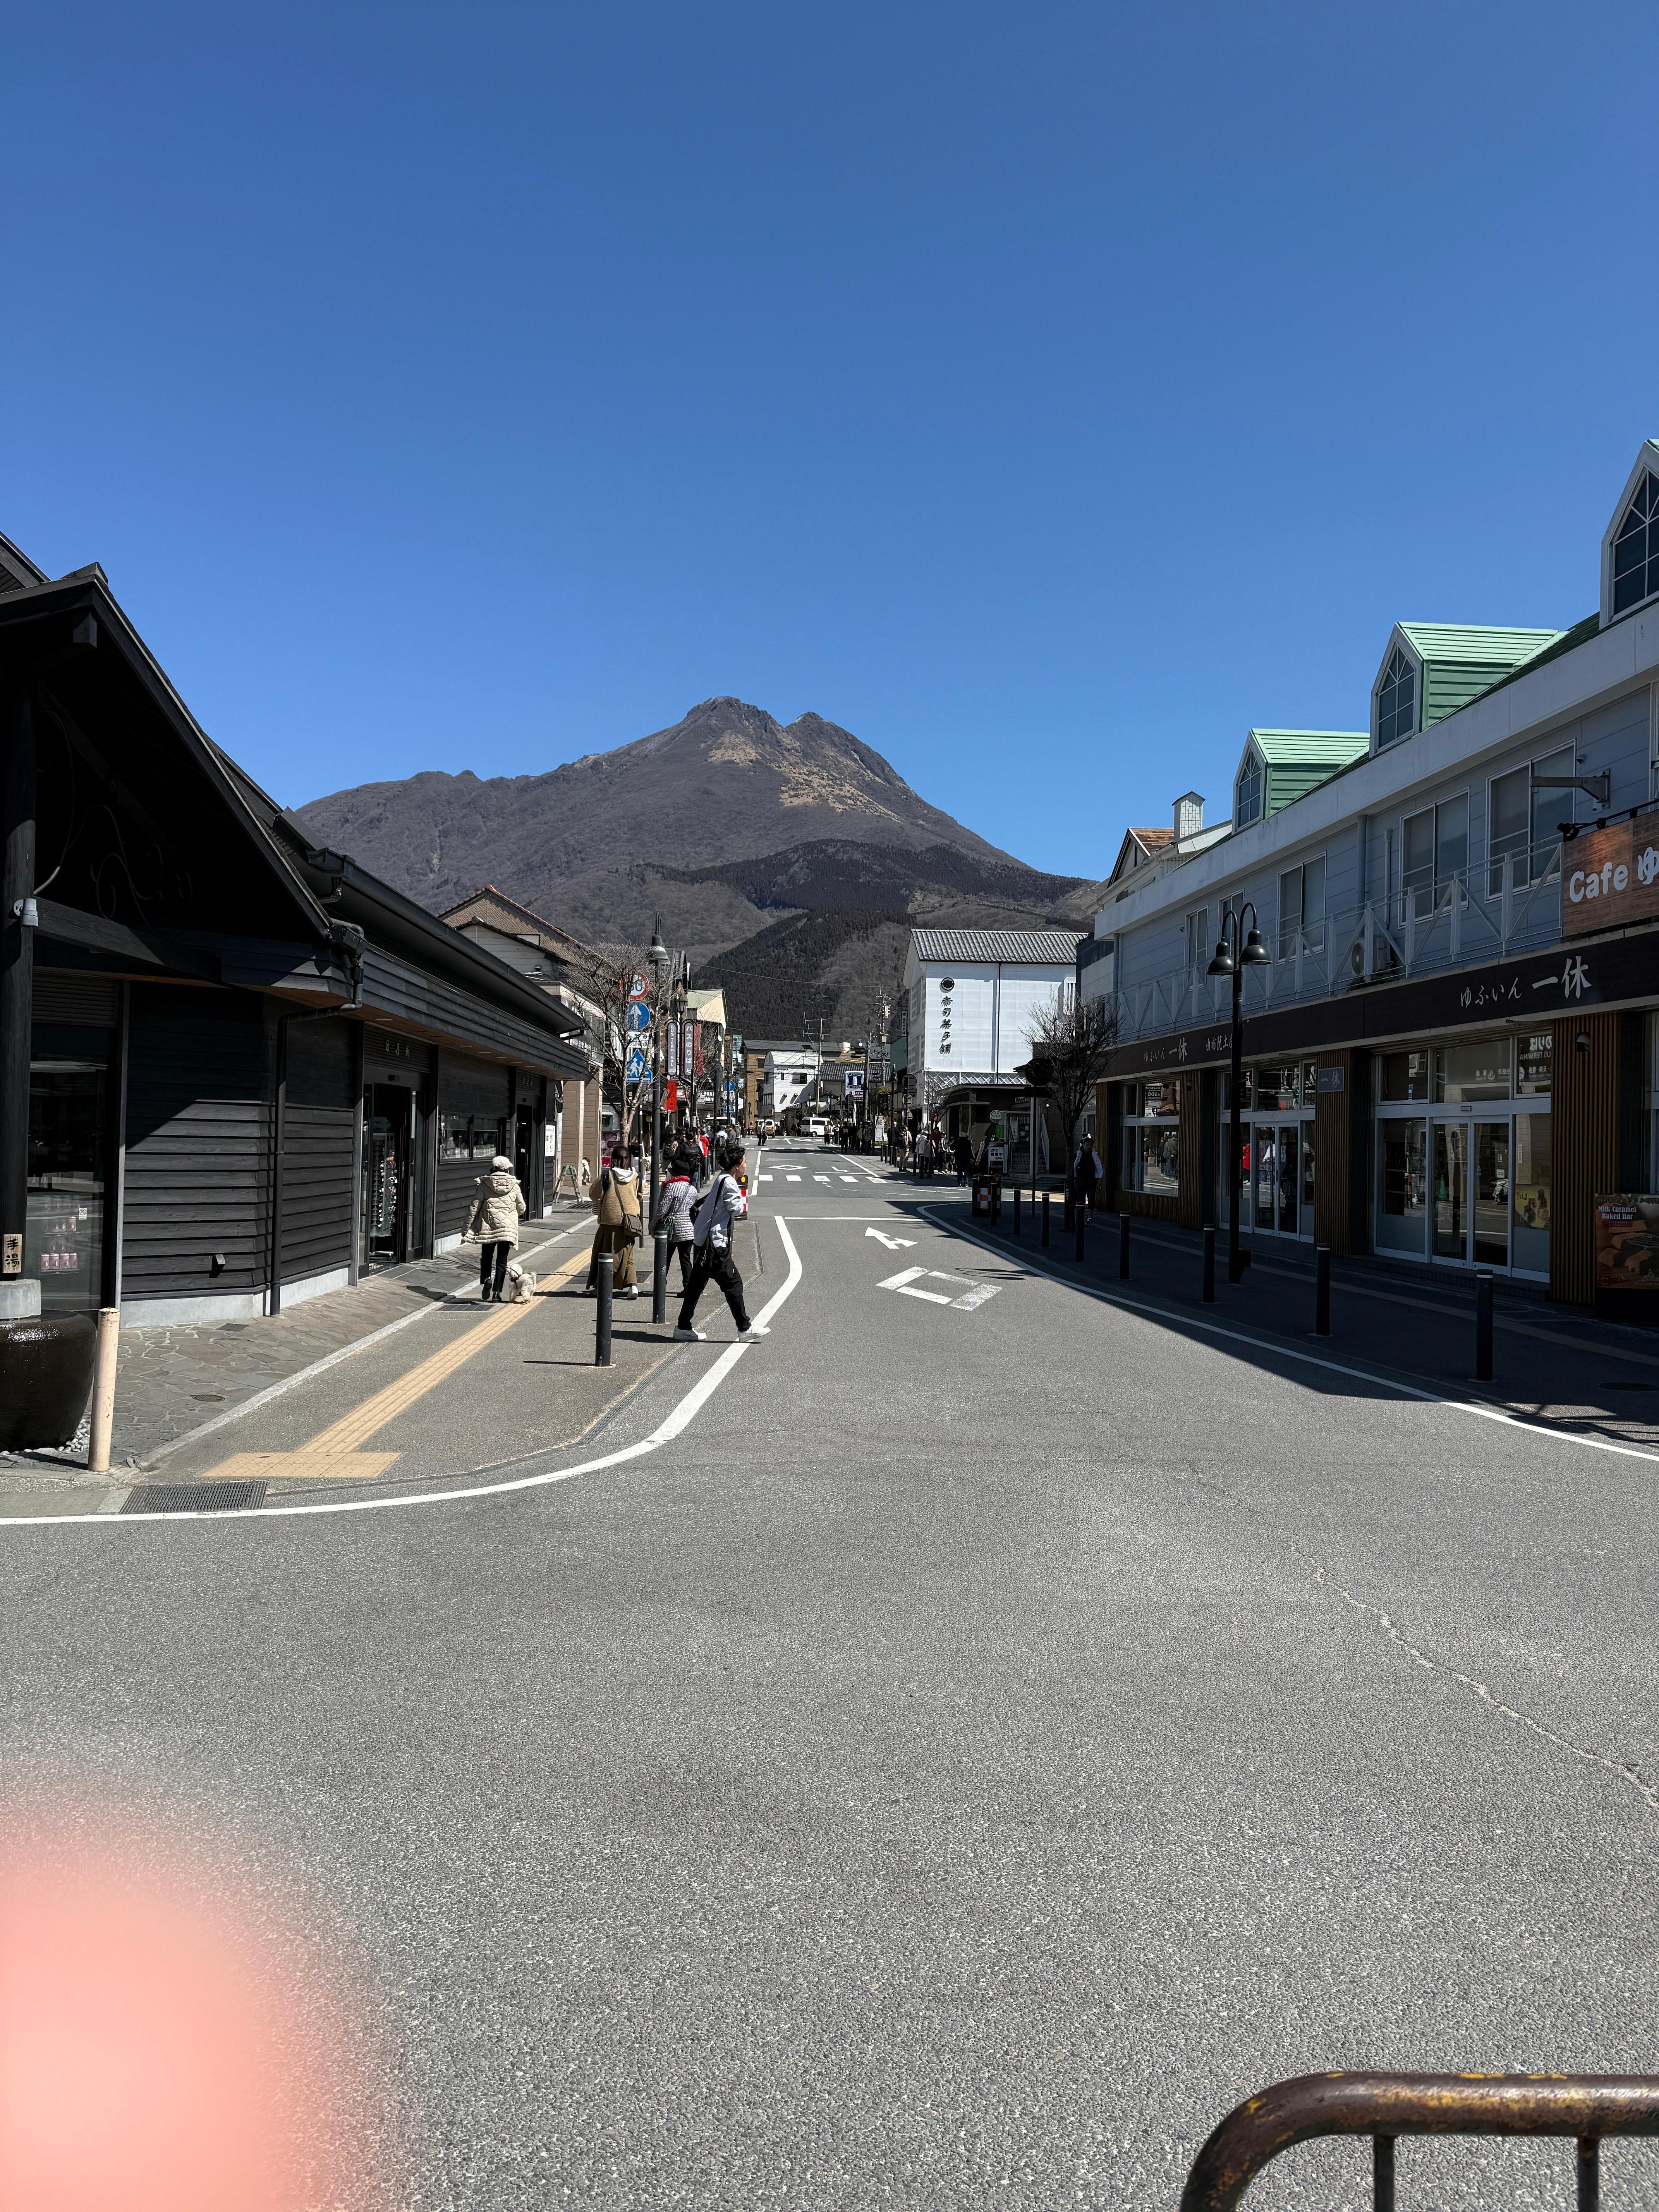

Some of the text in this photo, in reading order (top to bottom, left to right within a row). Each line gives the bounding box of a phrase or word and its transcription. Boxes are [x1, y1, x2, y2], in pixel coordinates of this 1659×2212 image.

[1570, 862, 1628, 903] Cafe
[1460, 955, 1593, 1009] ゆふいん 一休
[938, 995, 953, 1055] 赤司菓子舗
[1144, 1047, 1166, 1062] ゆふいん
[1168, 1037, 1188, 1061] 一休
[1320, 1070, 1340, 1089] 一休
[5, 1238, 19, 1267] 手湯
